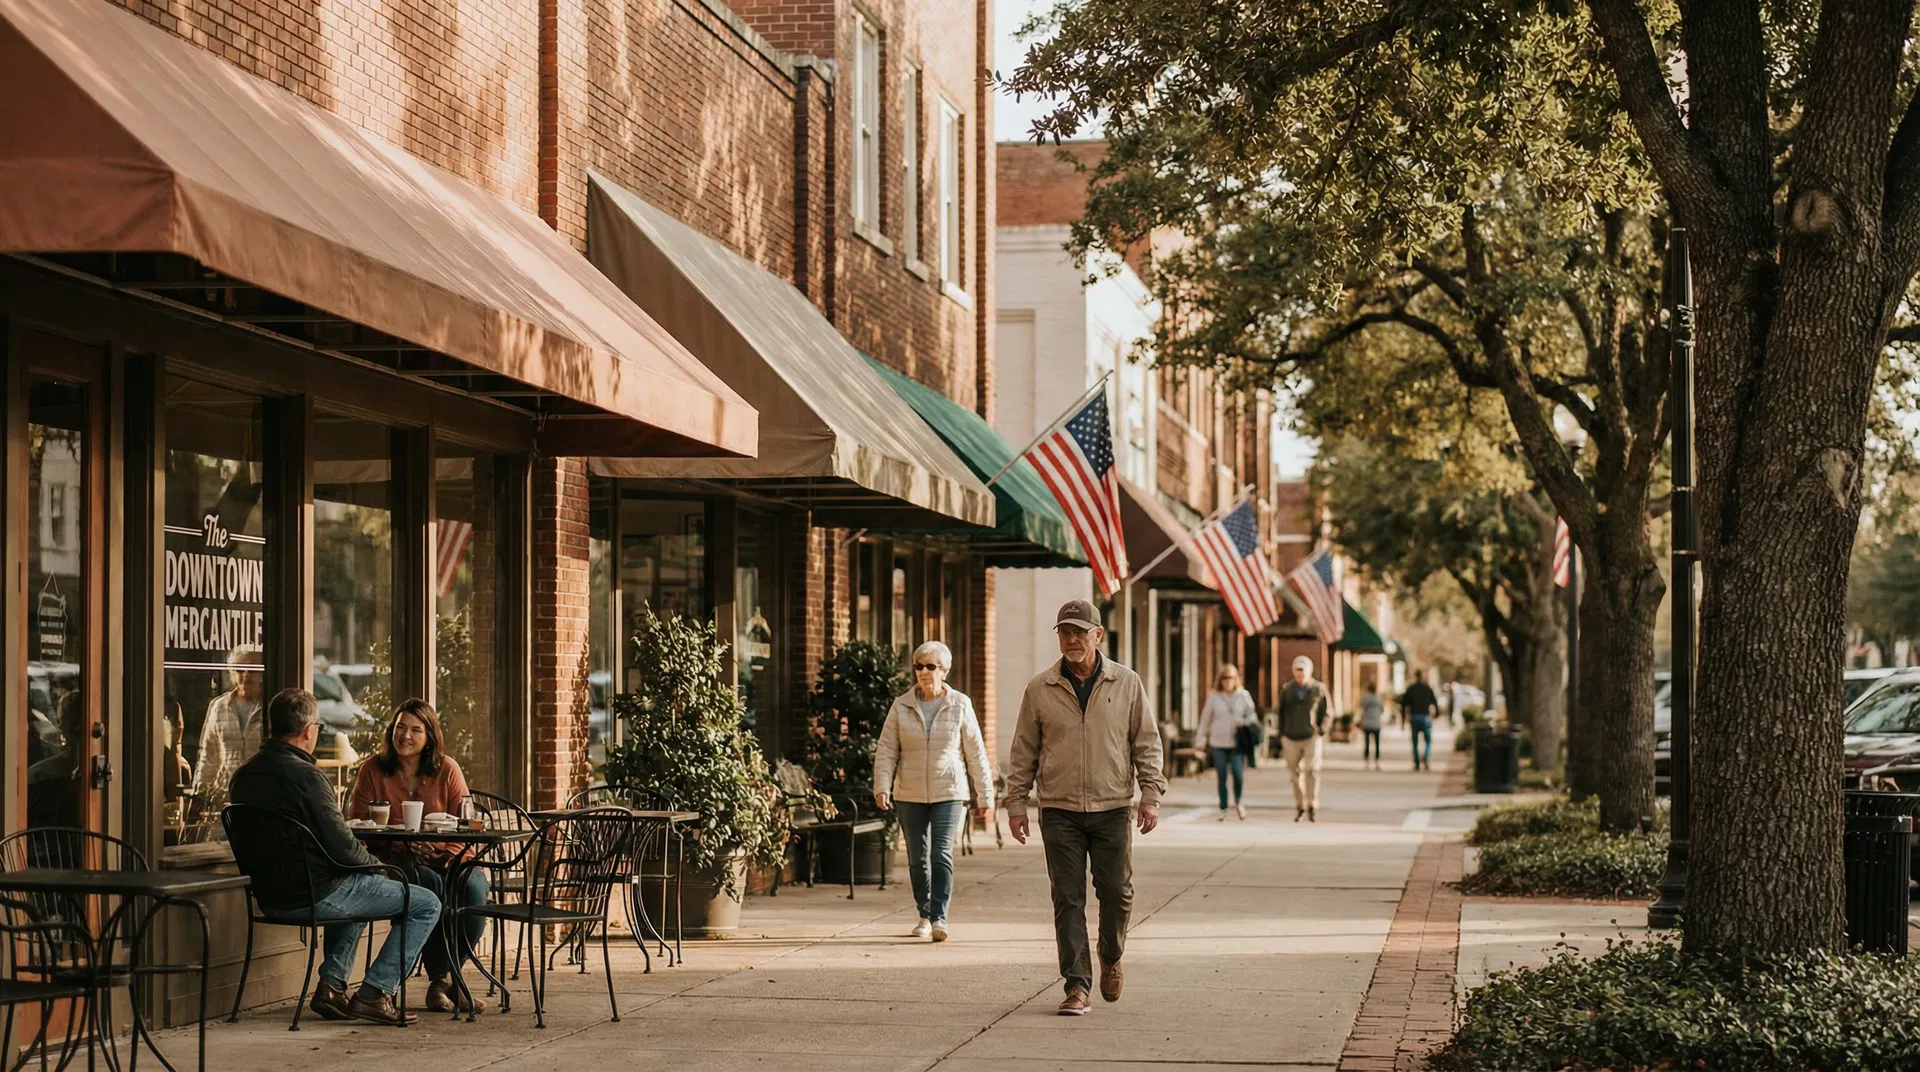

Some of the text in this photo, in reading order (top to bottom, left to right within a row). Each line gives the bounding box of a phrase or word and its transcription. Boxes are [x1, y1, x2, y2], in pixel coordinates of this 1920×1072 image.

[204, 514, 228, 548] The
[165, 550, 263, 603] DOWNTOWN
[165, 605, 263, 652] MERCANTILE
